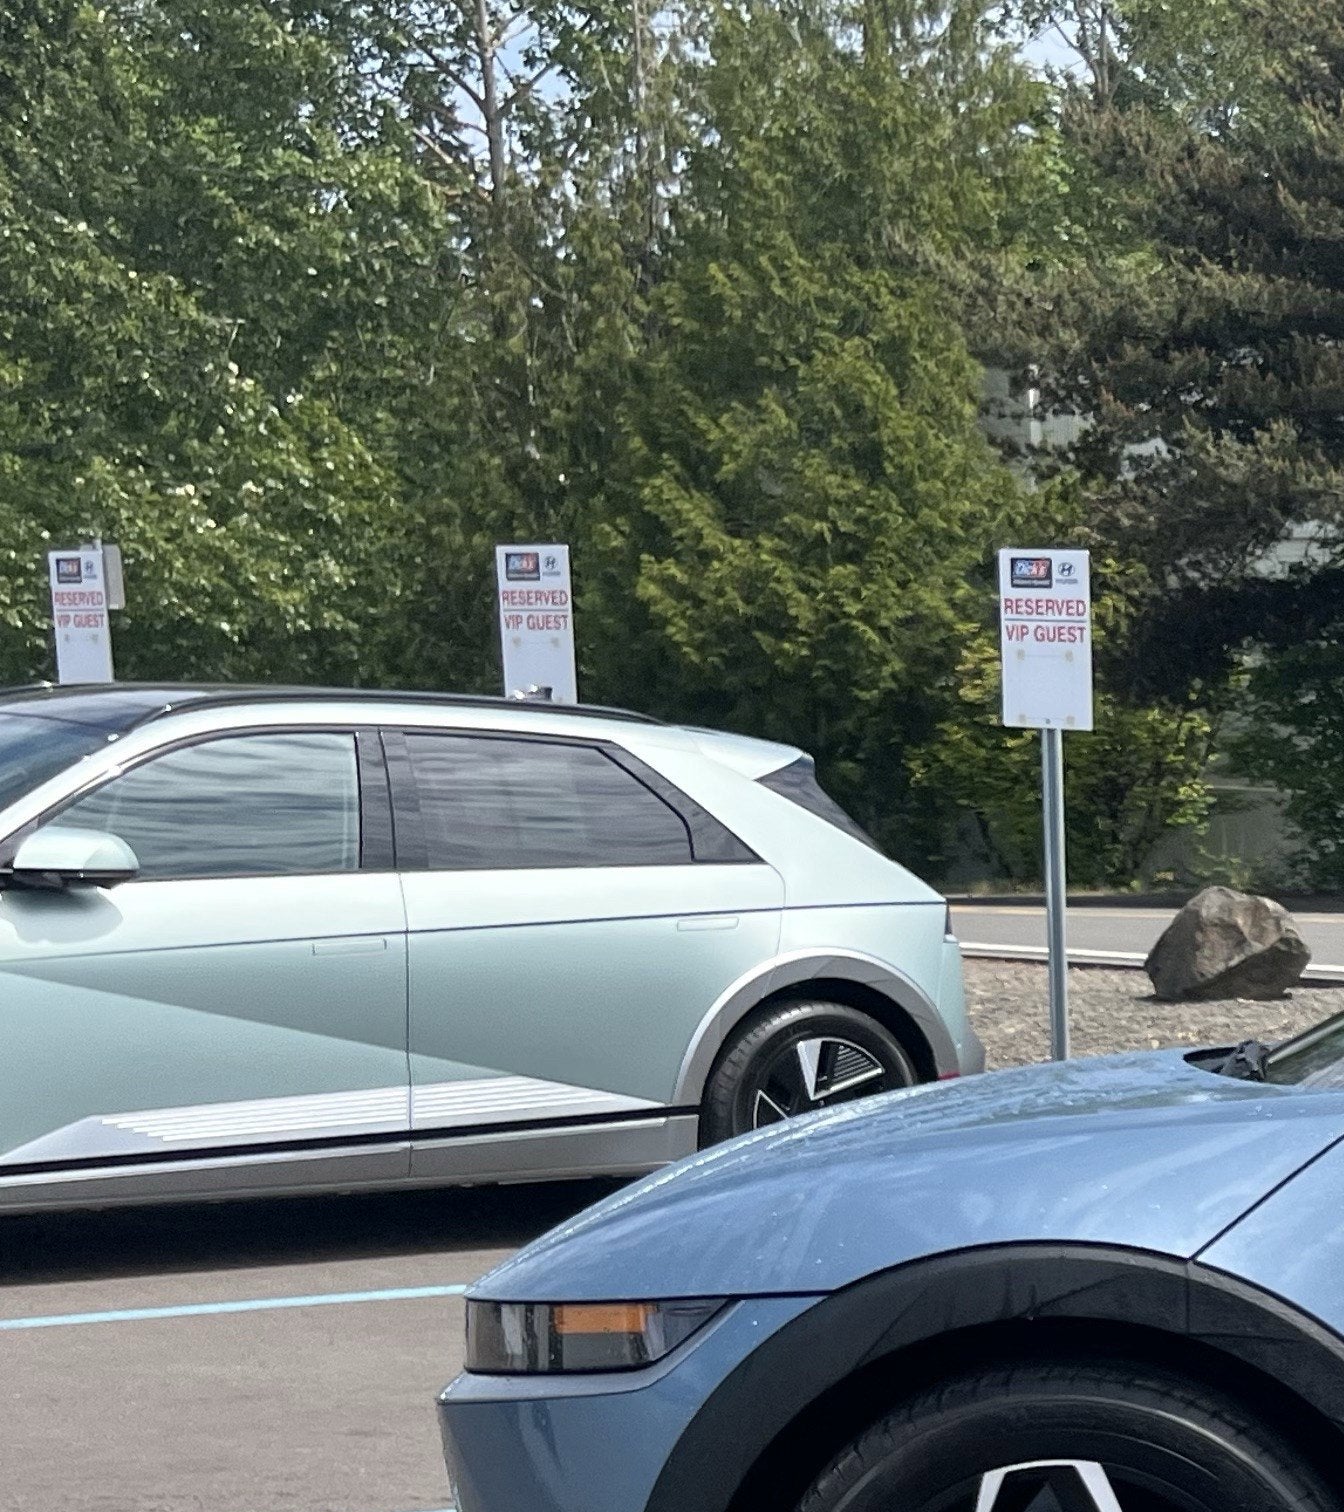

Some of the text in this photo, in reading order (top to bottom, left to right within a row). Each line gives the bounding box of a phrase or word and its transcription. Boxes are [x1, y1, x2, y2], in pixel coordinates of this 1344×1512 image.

[502, 589, 569, 606] RESERVED
[1004, 598, 1087, 617] RESERVED
[504, 614, 569, 631] VIP GUEST
[1006, 625, 1087, 644] VIP GUEST
